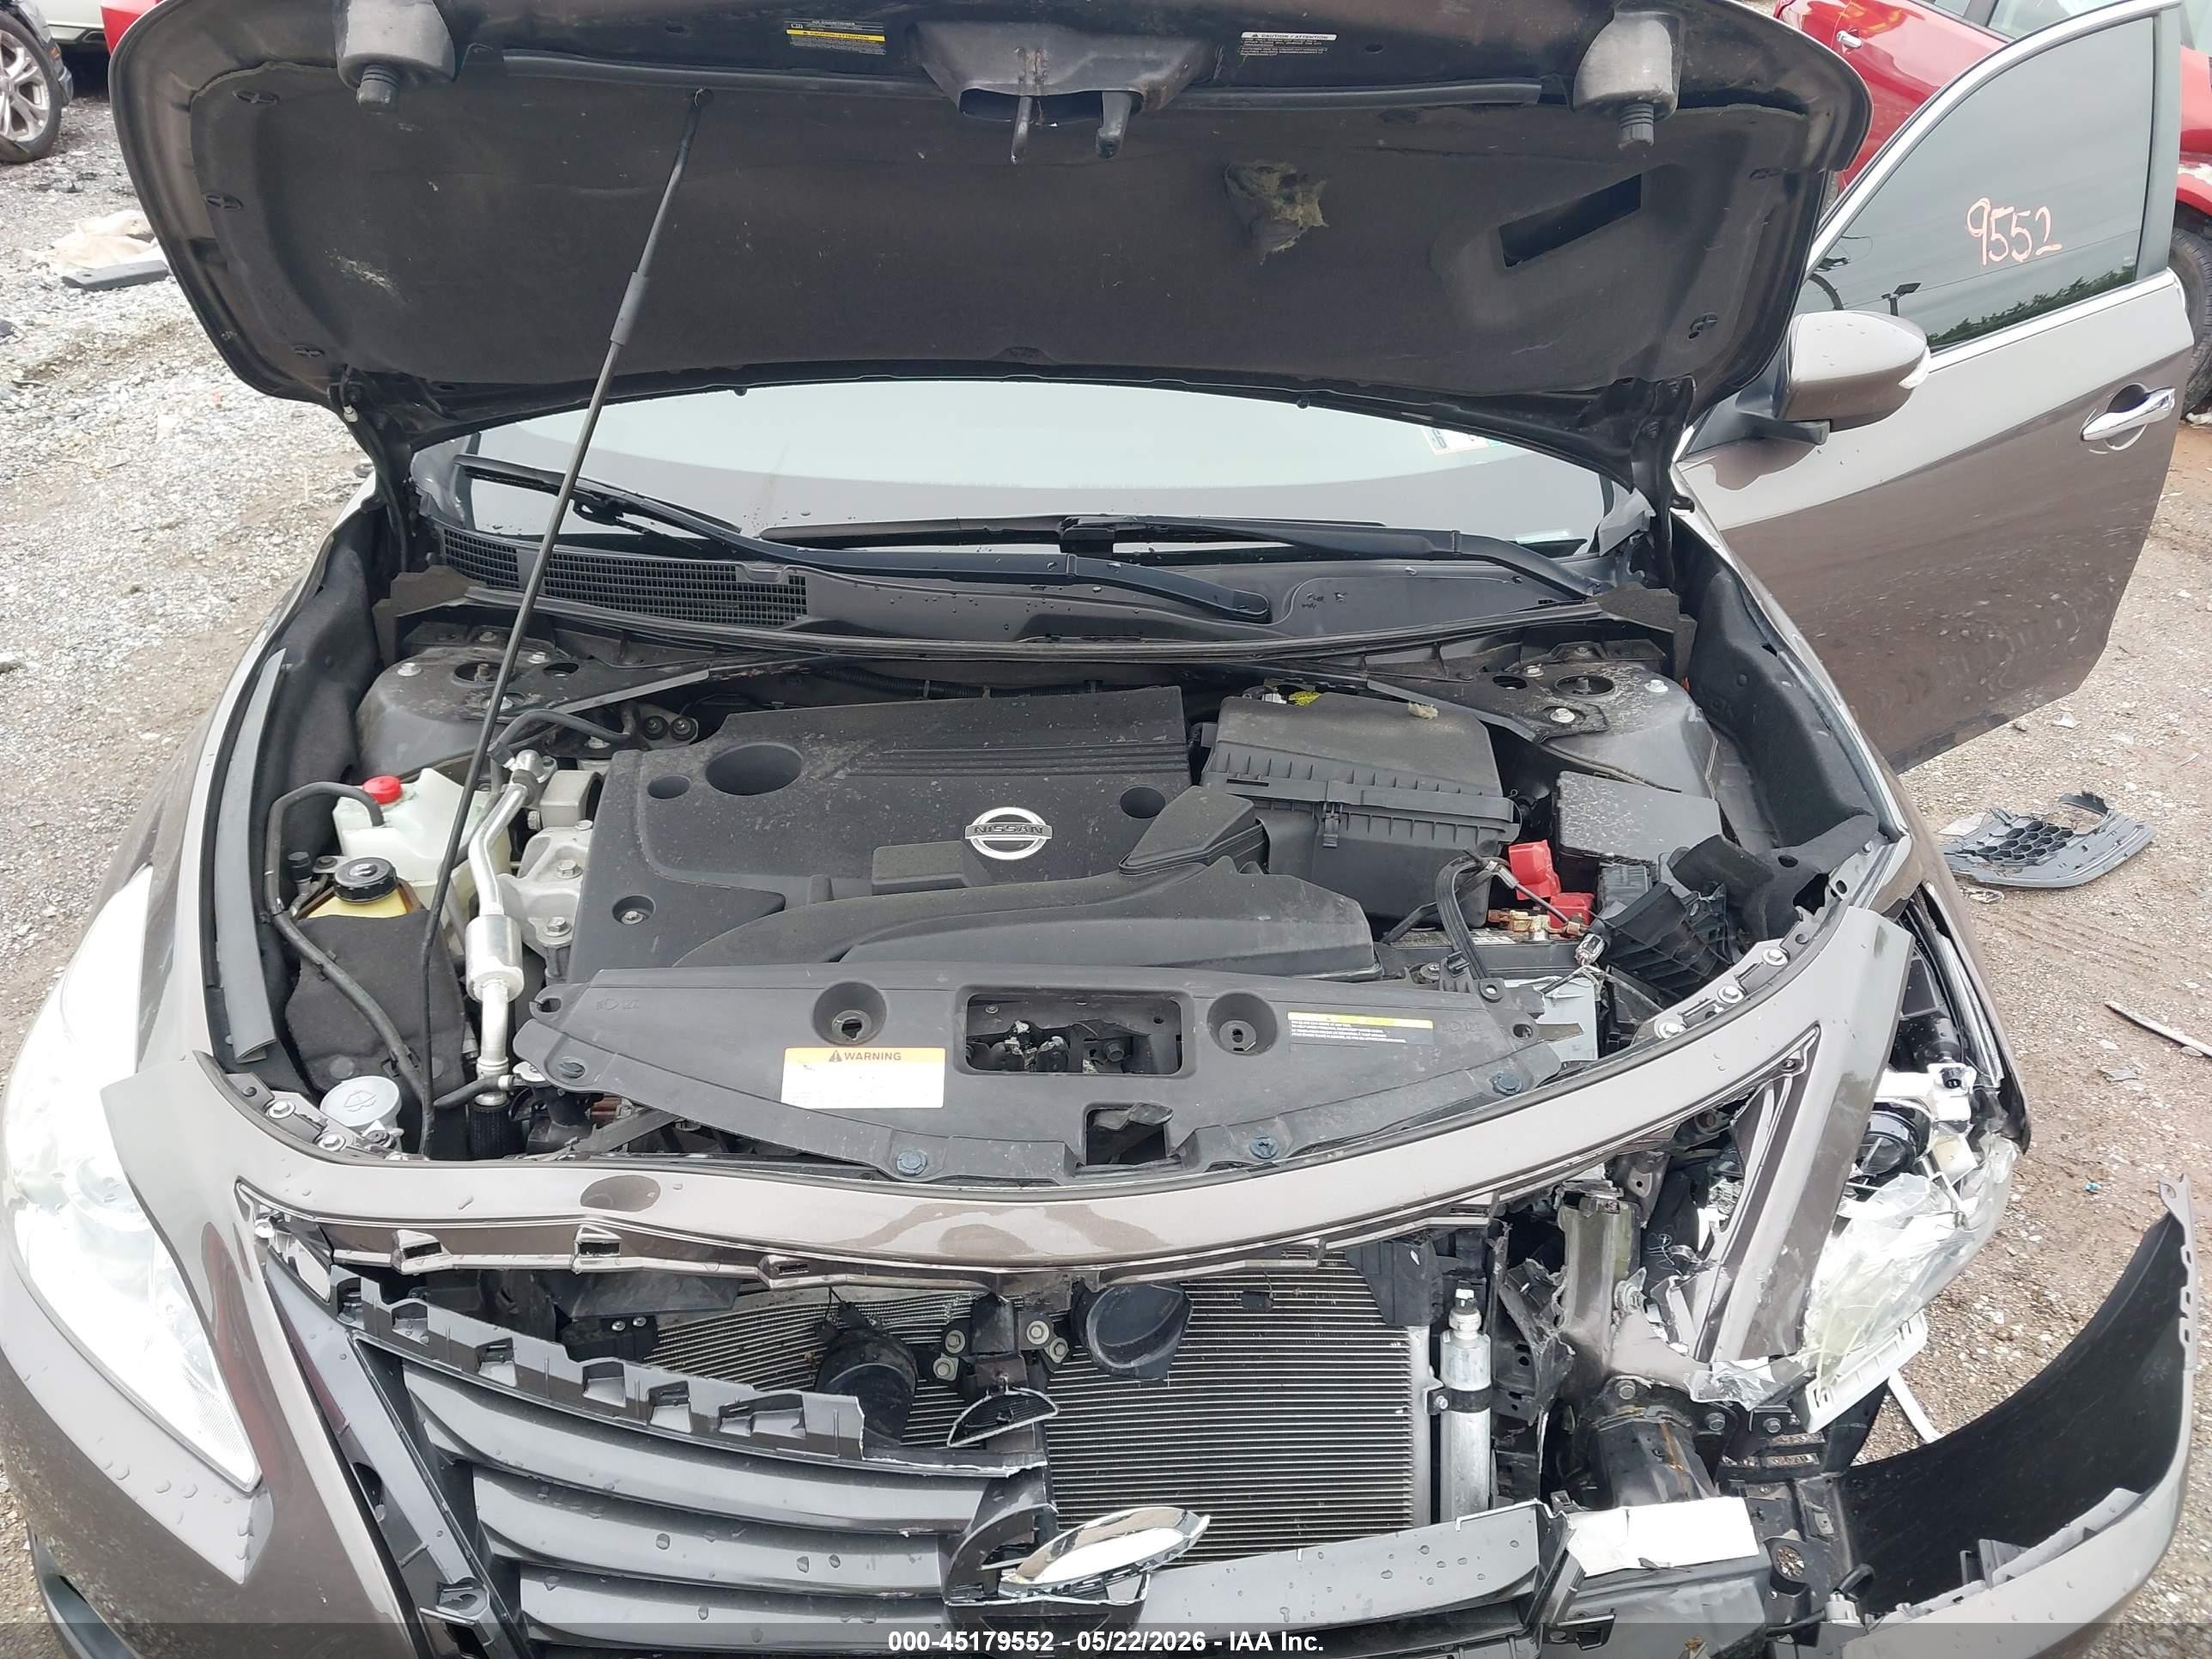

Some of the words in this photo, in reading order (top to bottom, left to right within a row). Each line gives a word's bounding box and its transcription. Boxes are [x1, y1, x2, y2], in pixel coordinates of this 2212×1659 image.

[1966, 197, 2063, 266] 9552
[973, 824, 1043, 835] NISSAN
[844, 1051, 902, 1061] WARNING
